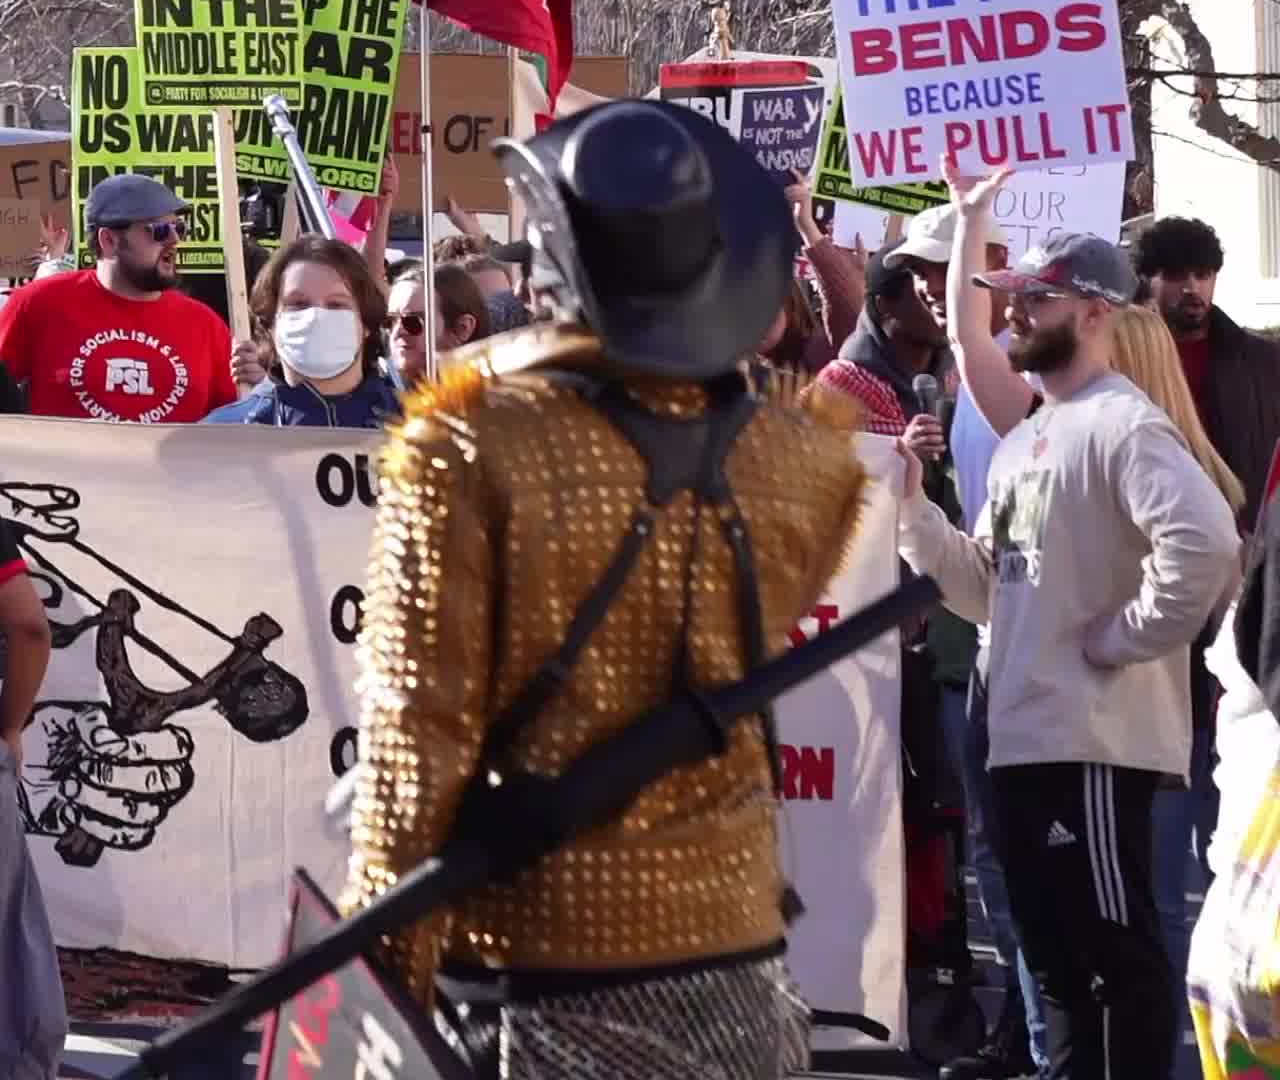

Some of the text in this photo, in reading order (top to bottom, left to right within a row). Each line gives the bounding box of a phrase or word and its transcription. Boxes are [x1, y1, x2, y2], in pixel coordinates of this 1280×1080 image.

[143, 32, 298, 75] MIDDLE EAST
[850, 2, 1107, 76] BENDS
[82, 55, 128, 110] NO
[905, 72, 1045, 116] BECAUSE
[753, 98, 796, 122] WAR
[80, 114, 131, 153] US
[443, 114, 493, 153] OF
[755, 127, 784, 145] NOT
[854, 104, 1127, 179] WE PULL IT
[70, 357, 86, 387] FOR
[80, 329, 160, 357] SOCIALISM
[105, 358, 155, 396] PSL
